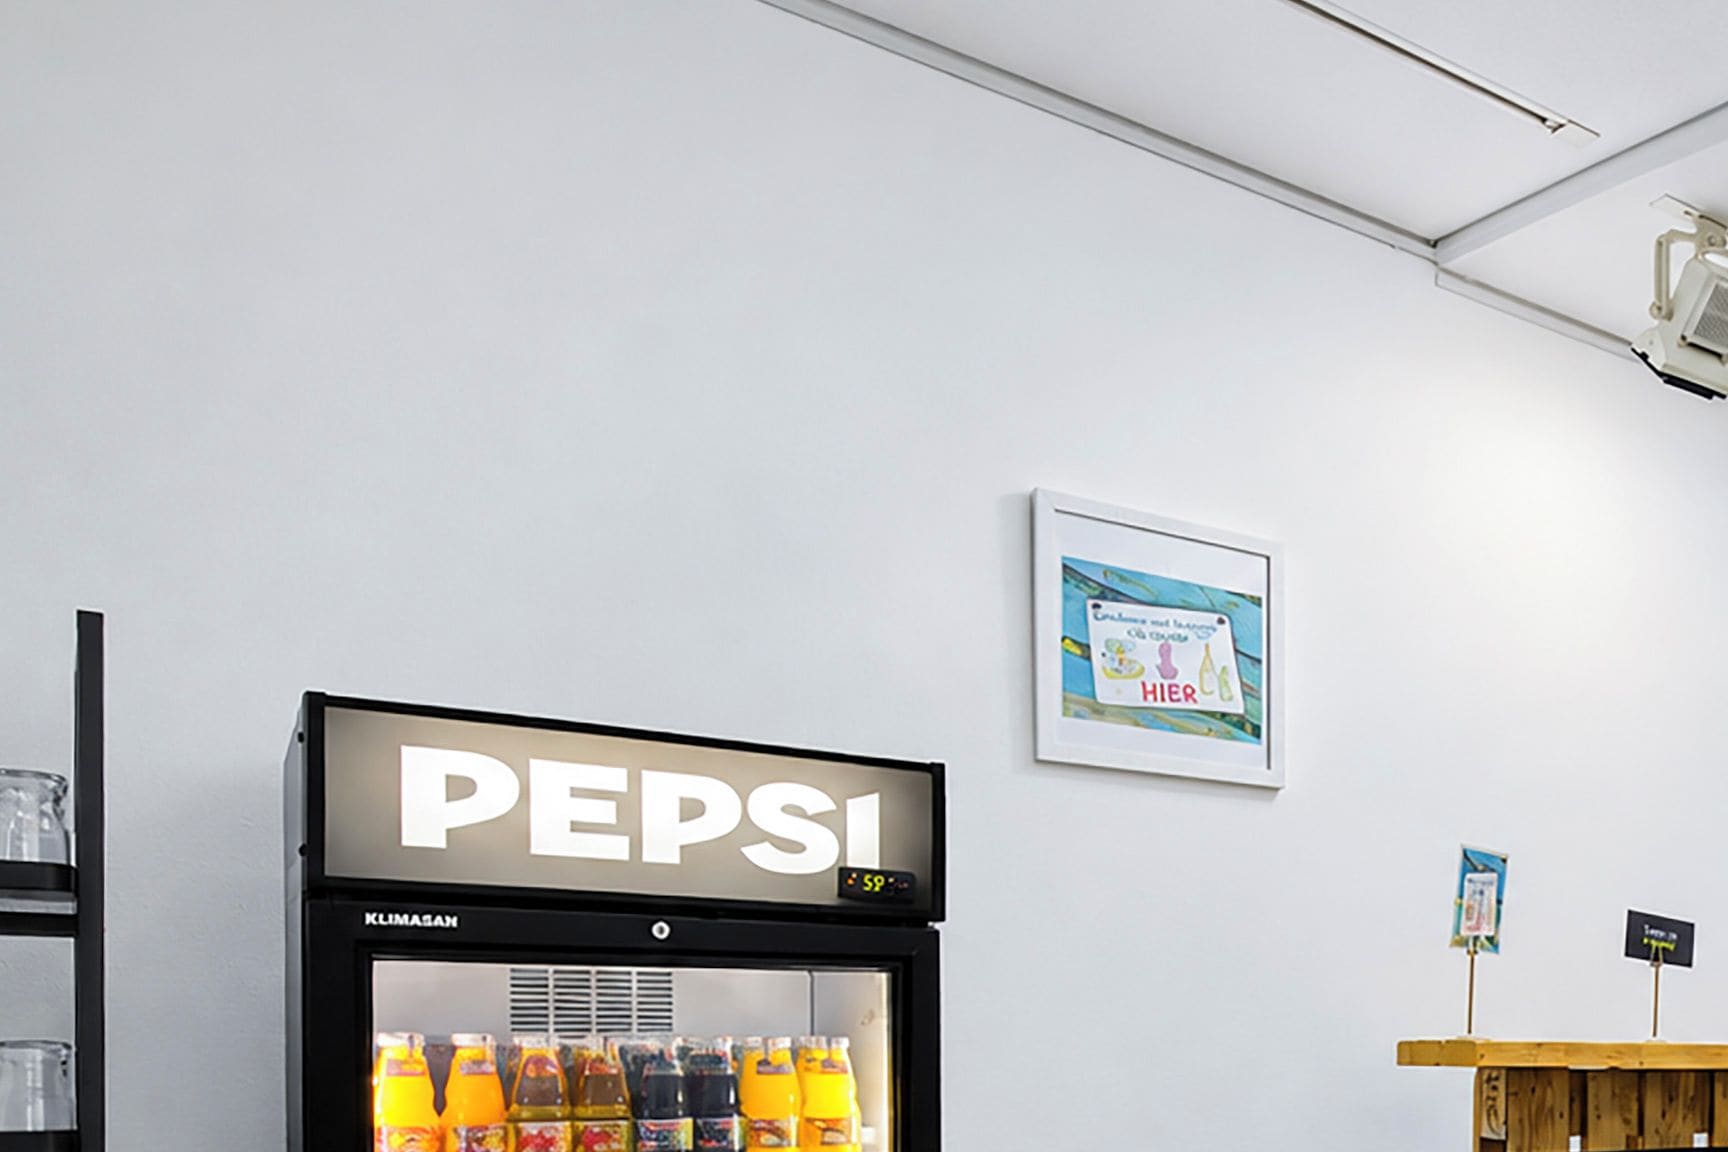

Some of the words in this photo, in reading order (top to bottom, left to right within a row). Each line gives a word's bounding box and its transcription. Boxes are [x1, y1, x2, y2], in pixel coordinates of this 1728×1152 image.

[1141, 680, 1198, 703] HIER
[400, 745, 880, 875] PEPSI
[365, 911, 458, 928] KLIMASAN
